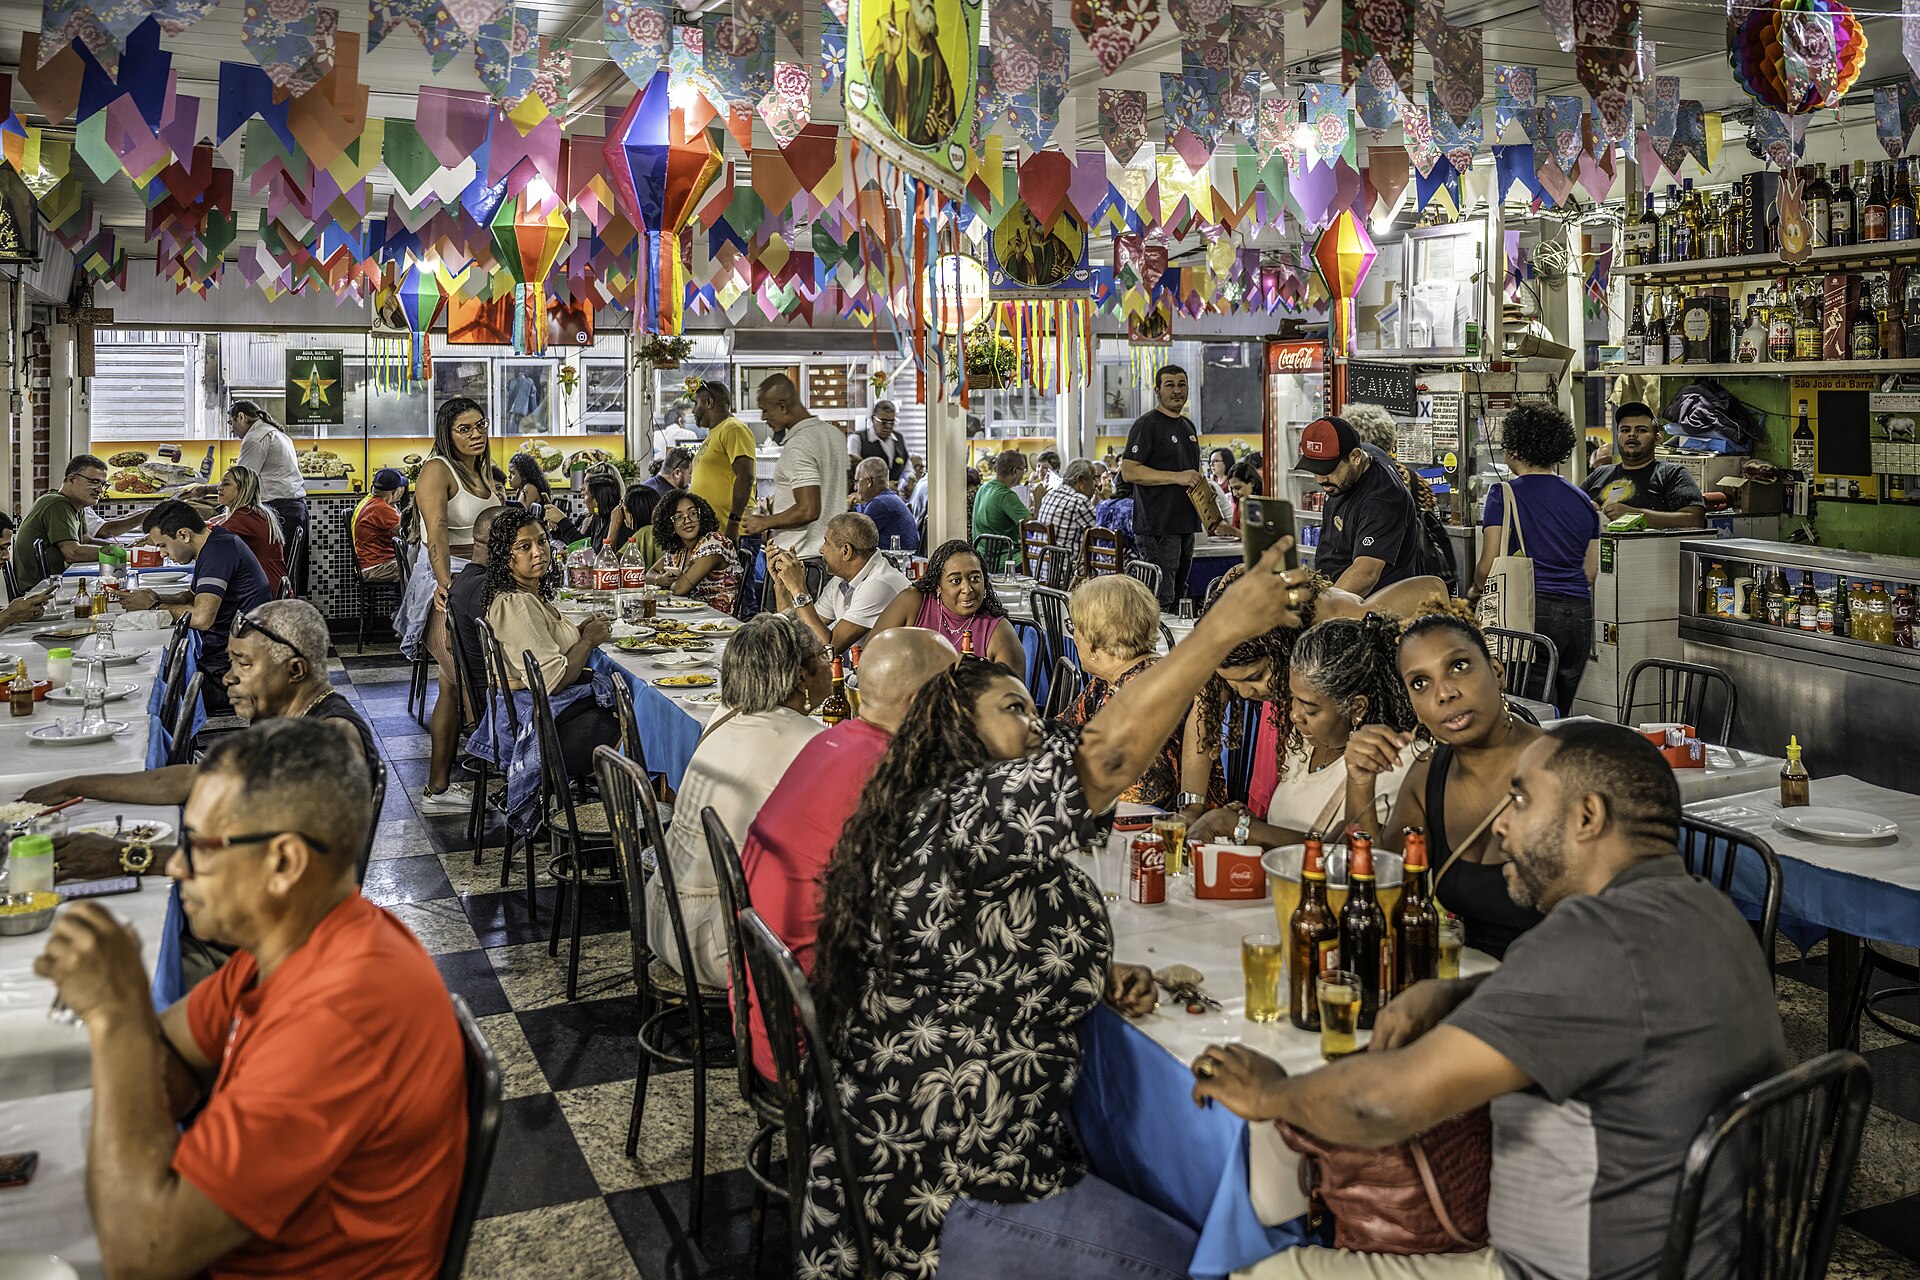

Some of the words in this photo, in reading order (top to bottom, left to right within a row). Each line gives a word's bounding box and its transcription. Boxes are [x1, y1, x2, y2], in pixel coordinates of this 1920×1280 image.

[1745, 174, 1753, 250] CHANDON
[1278, 347, 1314, 370] Coca-Cola
[1355, 376, 1405, 400] CAIXA
[1794, 379, 1810, 389] São
[1812, 379, 1833, 389] João
[1835, 379, 1846, 389] da
[1849, 379, 1874, 389] Barra
[1898, 606, 1908, 616] G
